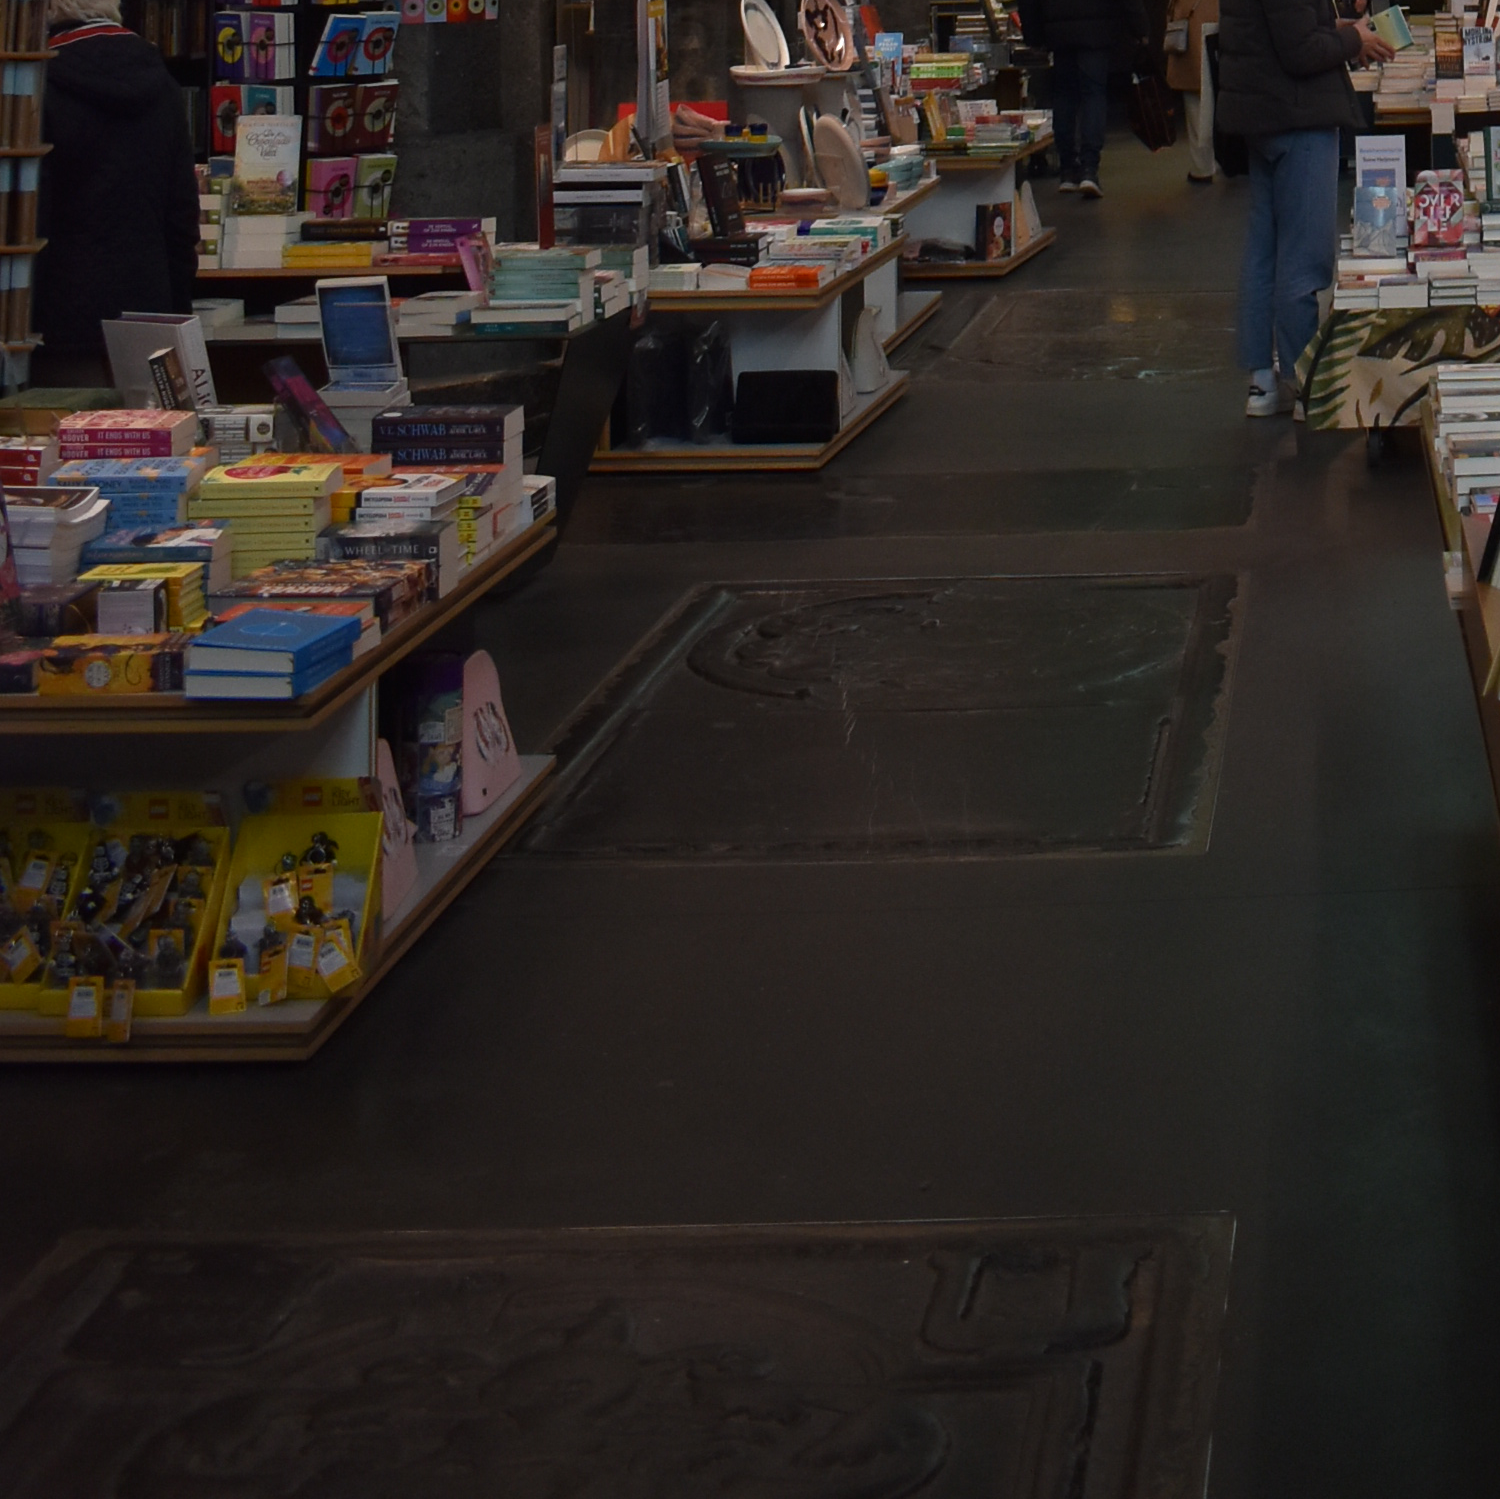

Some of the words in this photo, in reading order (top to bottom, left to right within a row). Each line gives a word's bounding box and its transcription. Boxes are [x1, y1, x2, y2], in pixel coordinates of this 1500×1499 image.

[397, 423, 446, 436] SCHWAB
[61, 433, 89, 442] HOOVER
[98, 431, 104, 439] IT
[105, 431, 123, 440] ENDS
[124, 431, 140, 439] WITH
[142, 431, 151, 439] US
[61, 450, 89, 458] HOOVER
[105, 448, 123, 456] ENDS
[124, 447, 140, 456] WITH
[142, 447, 151, 455] US
[397, 448, 446, 461] SCHWAB
[344, 546, 382, 555] WHEEL
[392, 544, 419, 554] TIME
